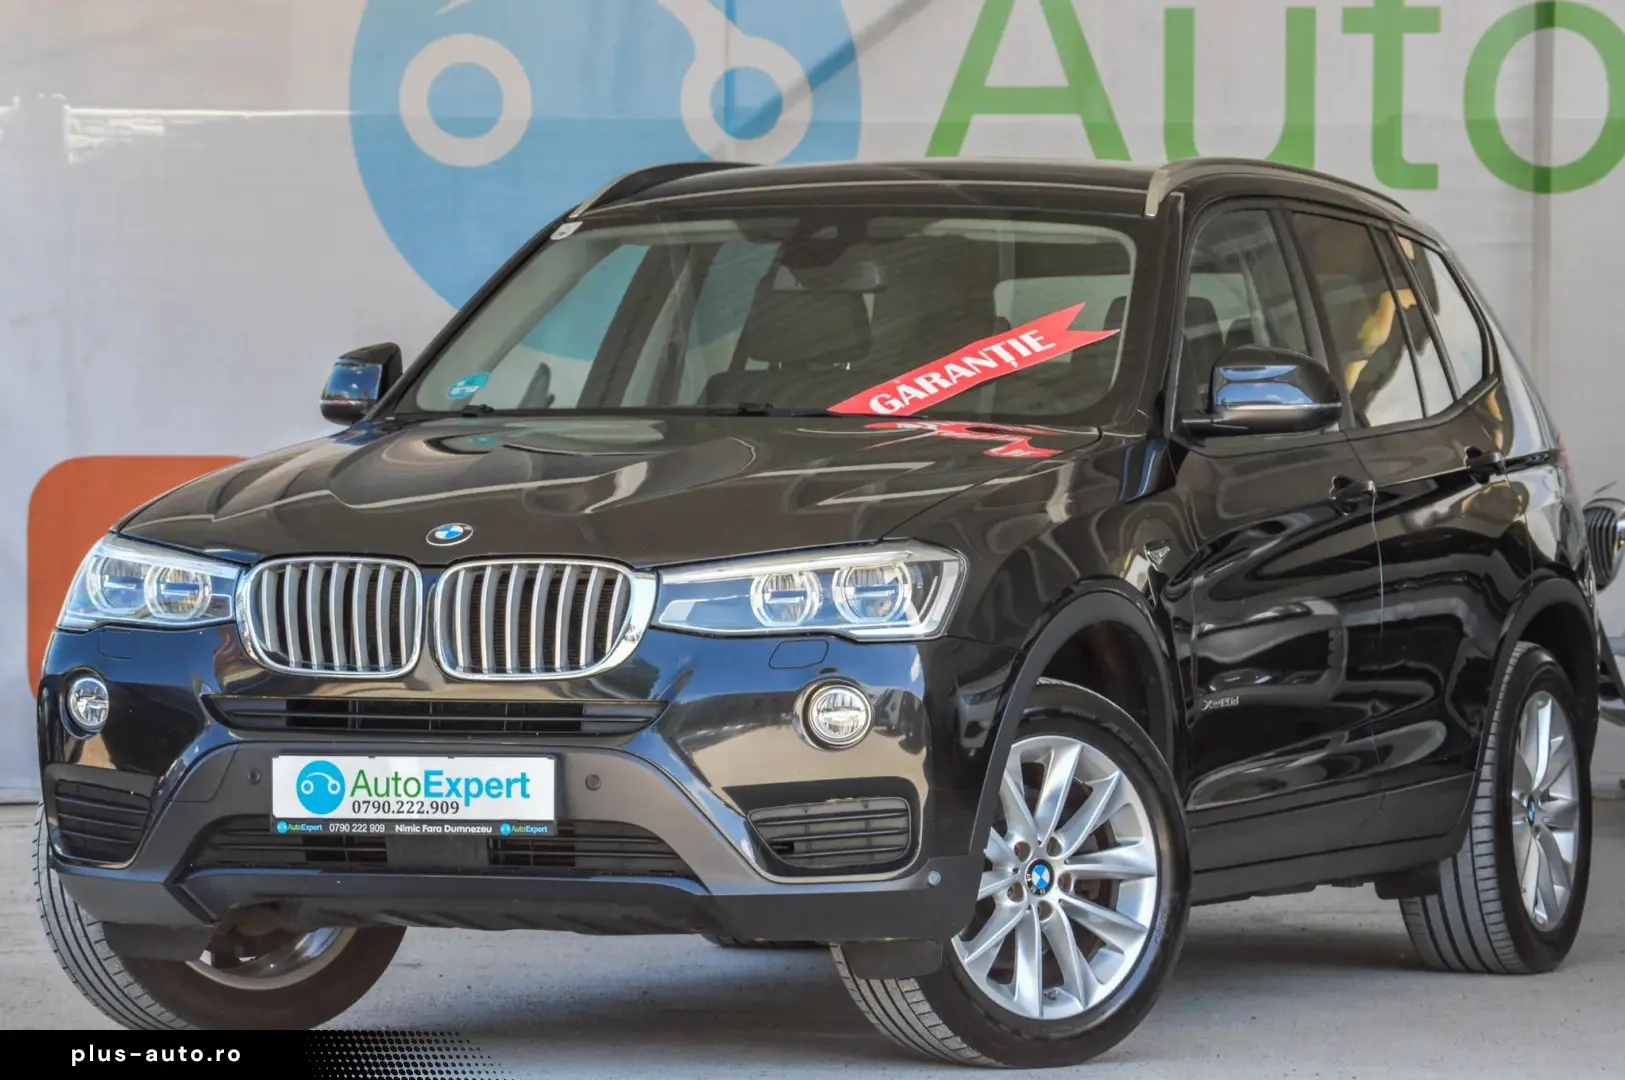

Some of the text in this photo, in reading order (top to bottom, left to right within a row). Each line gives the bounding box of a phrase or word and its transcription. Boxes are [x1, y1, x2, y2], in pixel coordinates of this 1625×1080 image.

[924, 0, 1625, 194] Auto
[350, 769, 531, 806] AutoExpert
[352, 800, 460, 815] 0790.222.909
[287, 823, 548, 834] AutoExpert 0790 222 909 Nimic Fara Dumnezeu AutoExpert
